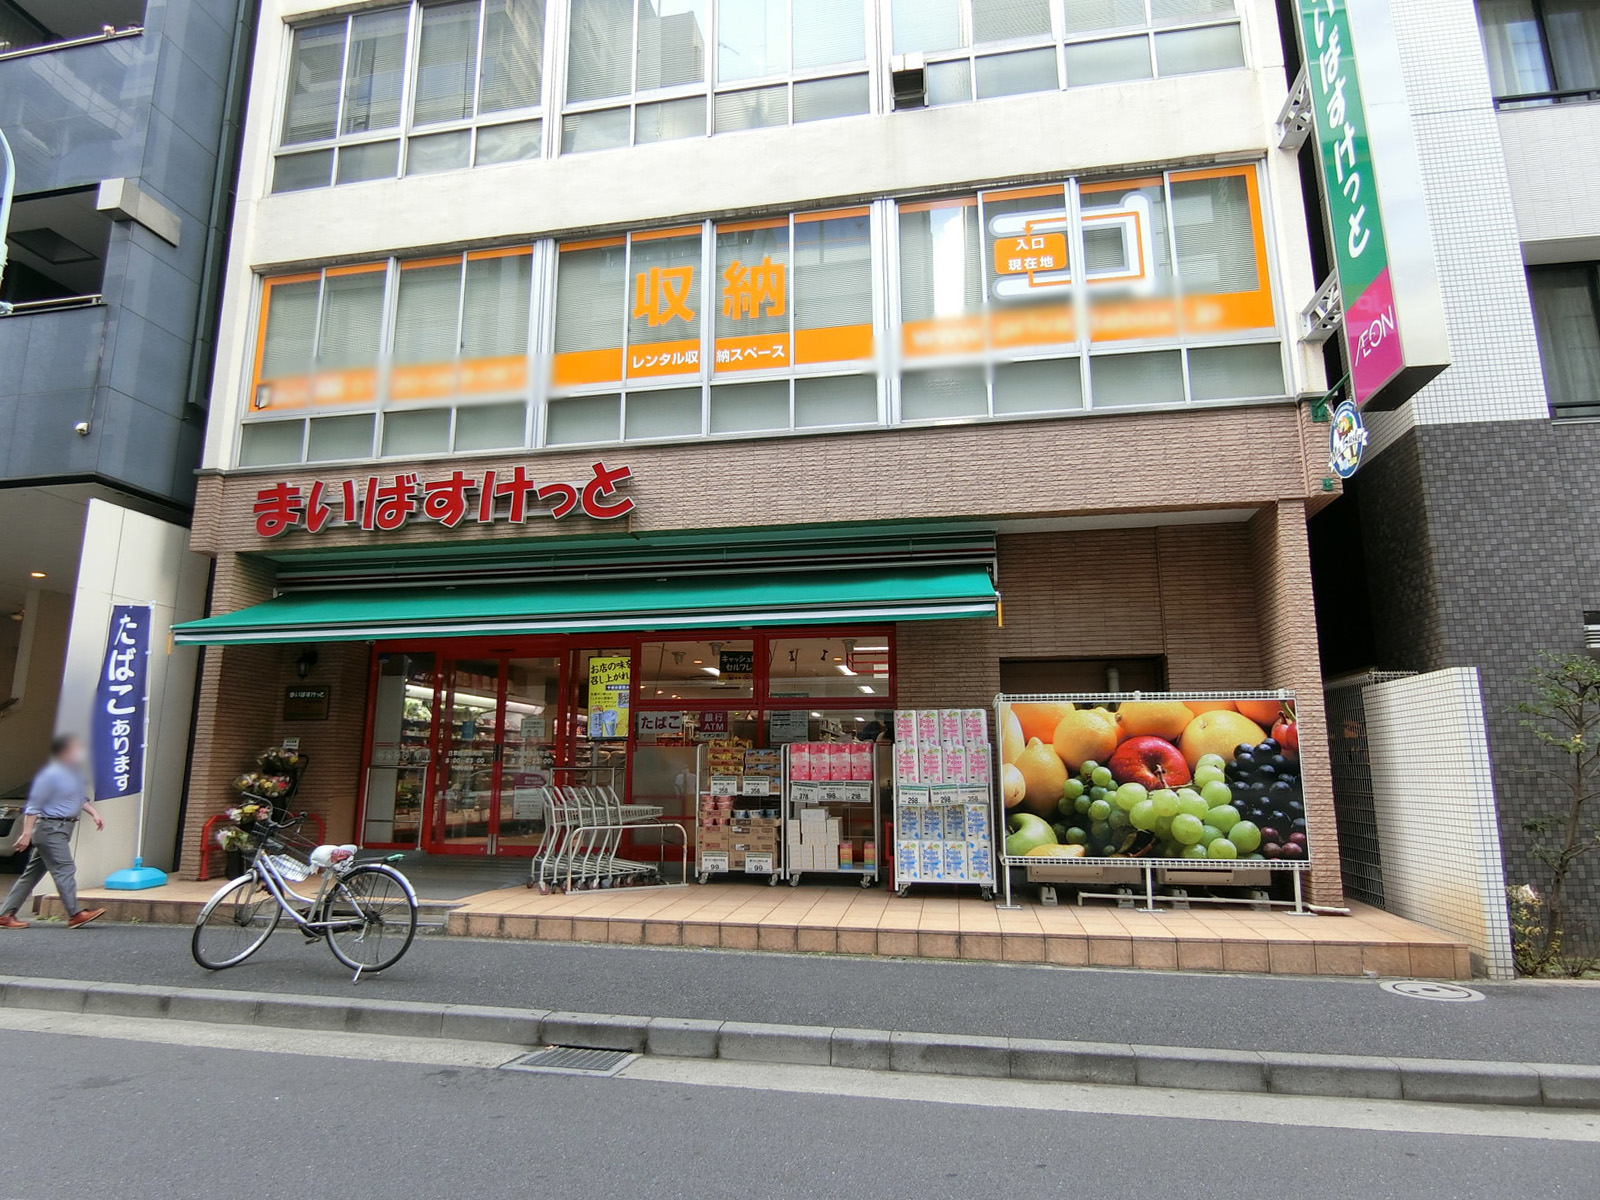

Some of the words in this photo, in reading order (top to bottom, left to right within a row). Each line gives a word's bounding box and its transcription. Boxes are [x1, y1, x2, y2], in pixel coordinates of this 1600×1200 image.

[1312, 0, 1370, 259] いばすけっと
[1016, 238, 1045, 251] 入口
[1008, 256, 1054, 271] 現在地
[632, 257, 787, 327] 収納
[253, 462, 636, 539] まいばすけっと
[641, 715, 681, 730] たばこ
[704, 713, 724, 722] 銀行
[704, 723, 724, 731] ATM
